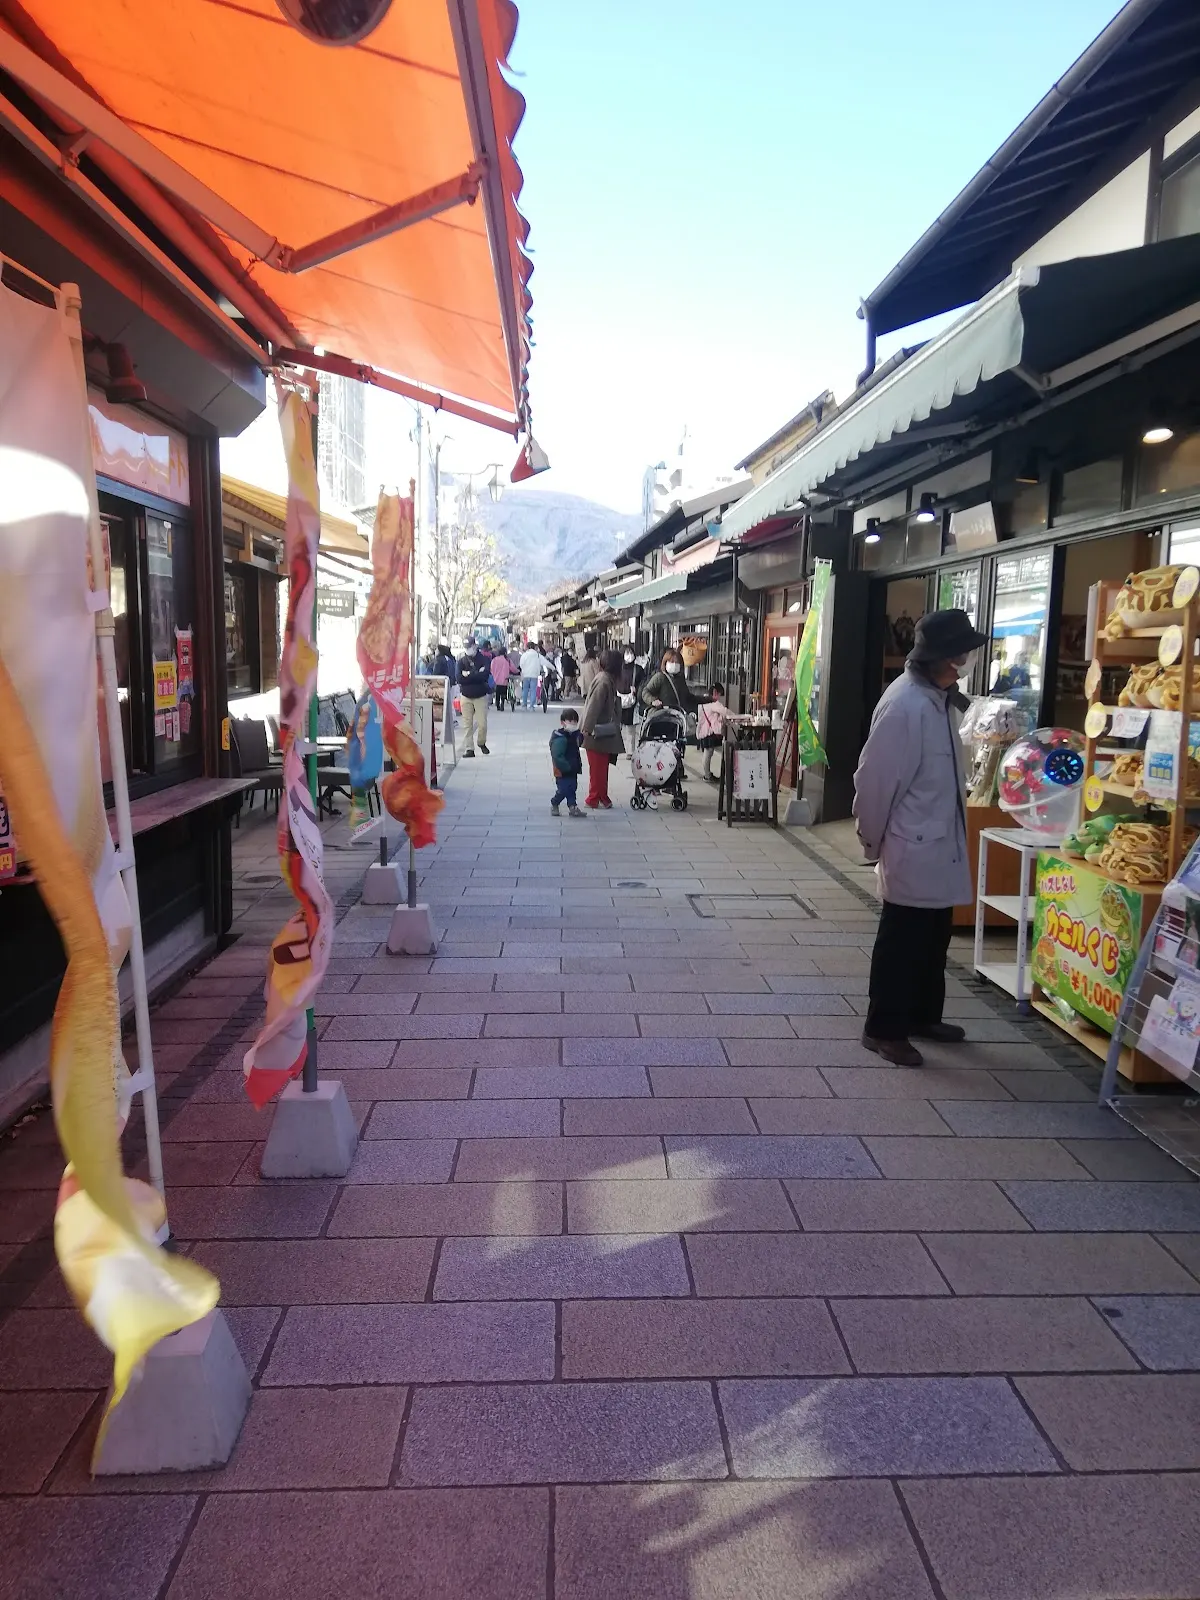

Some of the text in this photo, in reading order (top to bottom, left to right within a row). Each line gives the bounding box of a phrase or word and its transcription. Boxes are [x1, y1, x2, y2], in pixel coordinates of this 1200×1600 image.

[1040, 875, 1076, 894] ハズしなし
[1047, 904, 1119, 975] カエルくじ
